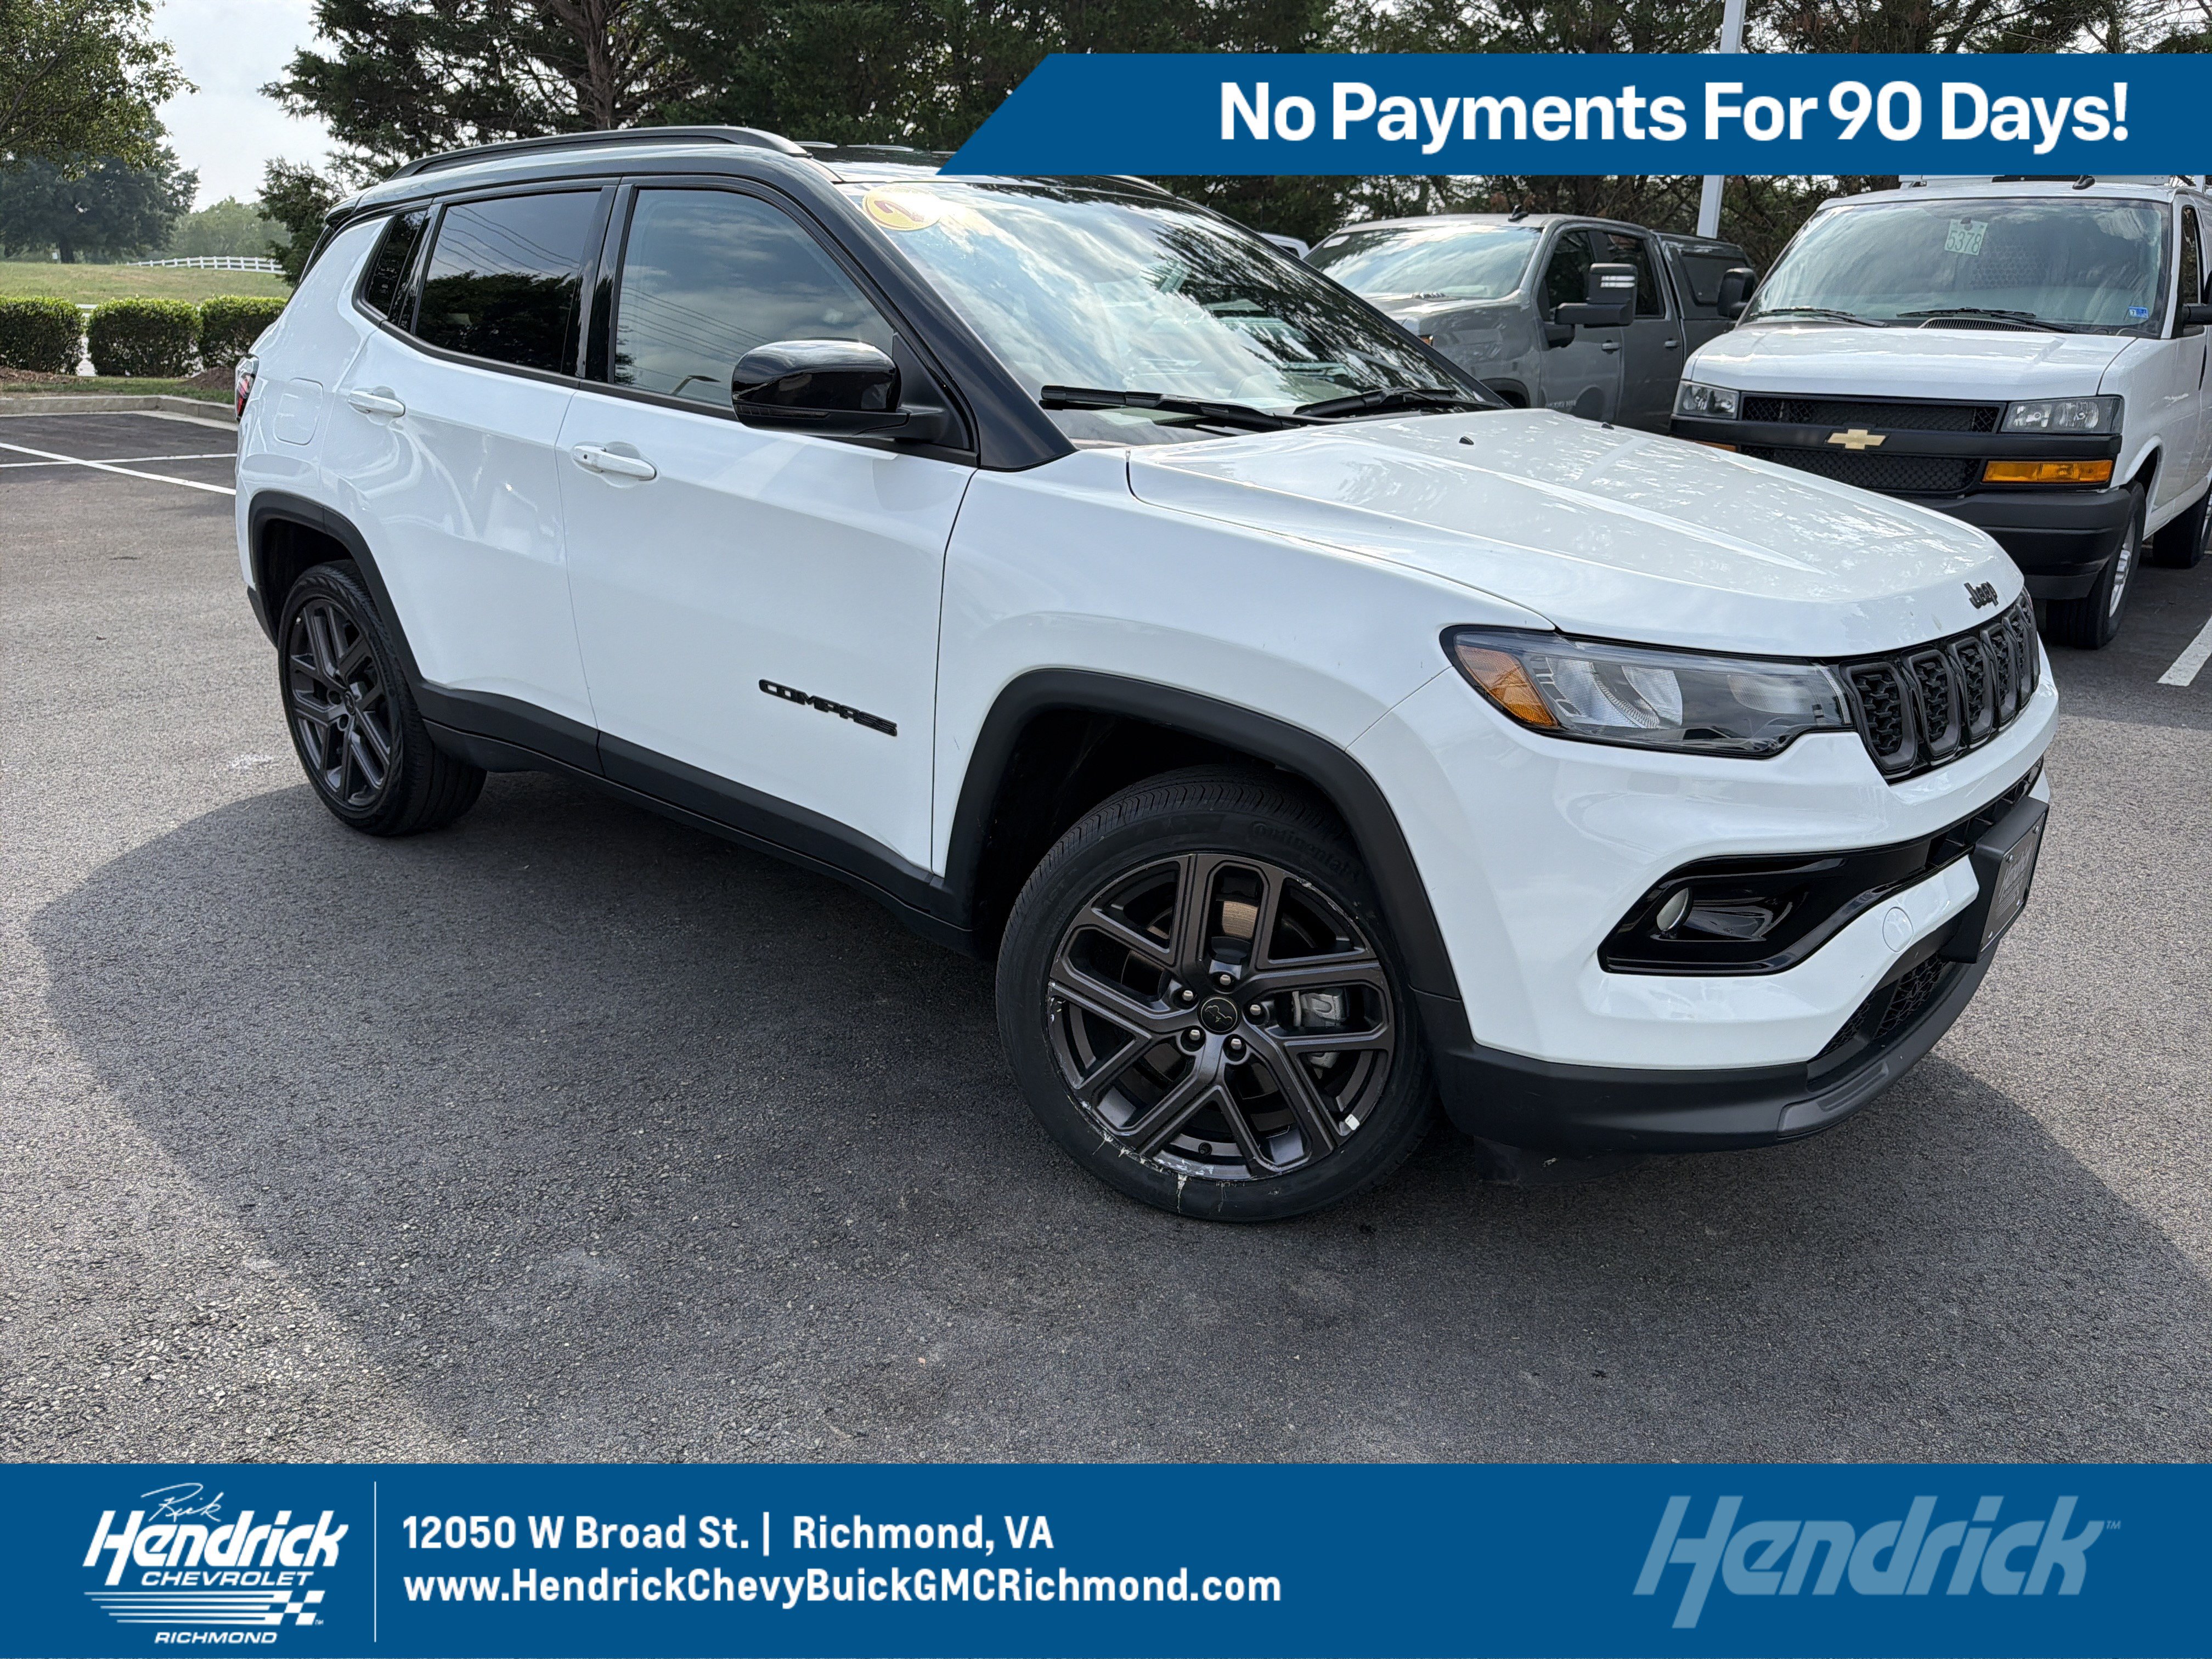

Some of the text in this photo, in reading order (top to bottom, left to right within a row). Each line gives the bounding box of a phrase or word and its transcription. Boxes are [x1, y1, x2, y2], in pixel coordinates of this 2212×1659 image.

[1947, 230, 1982, 253] 5378
[1964, 582, 1999, 609] Jeep
[759, 679, 898, 737] COMPASS
